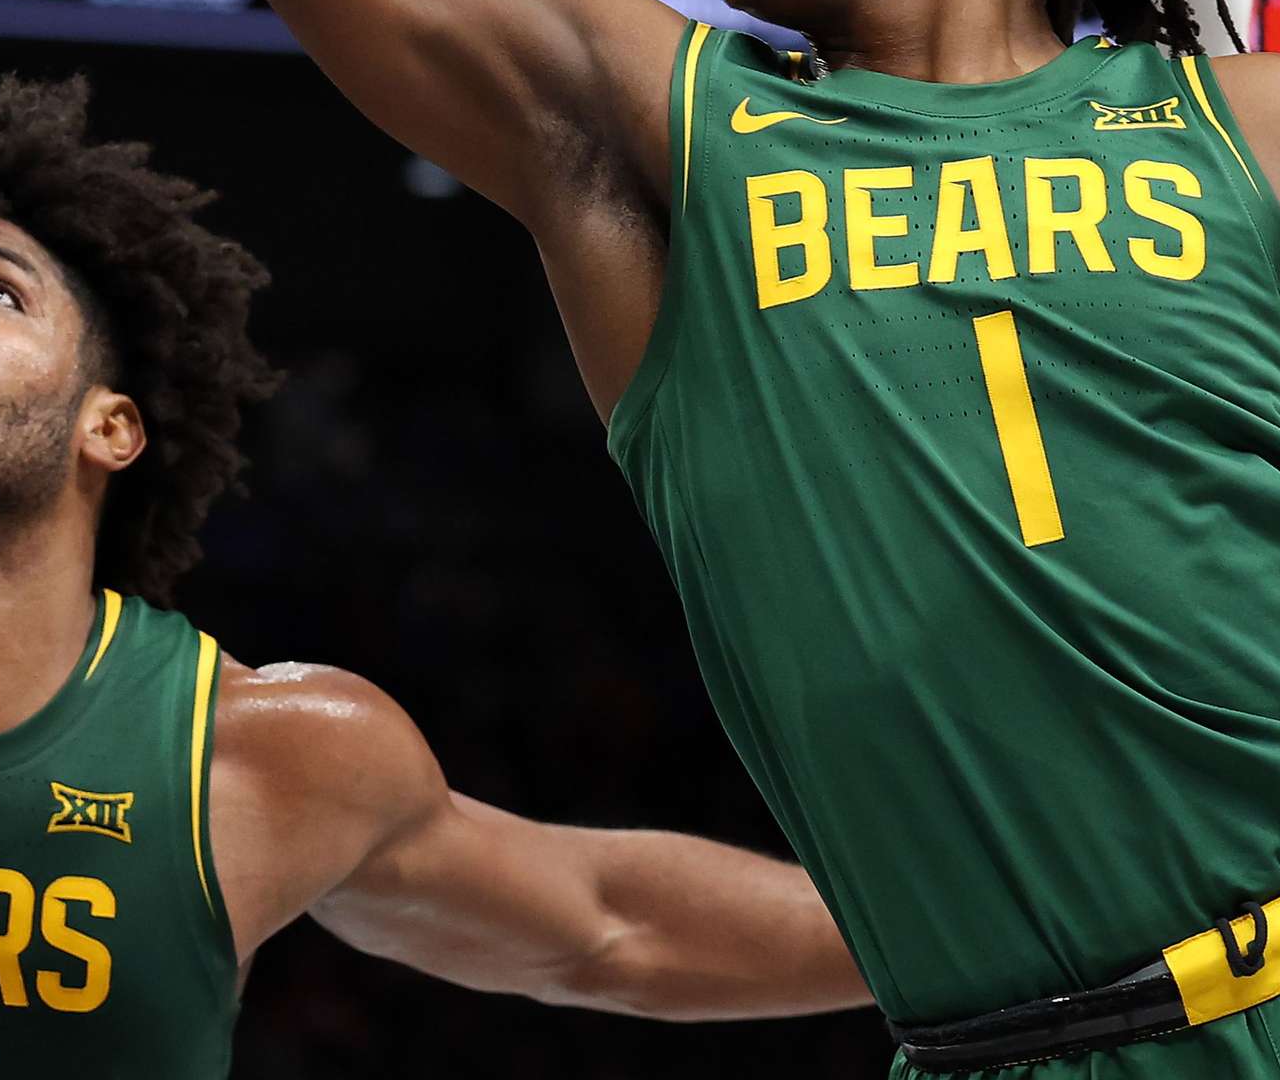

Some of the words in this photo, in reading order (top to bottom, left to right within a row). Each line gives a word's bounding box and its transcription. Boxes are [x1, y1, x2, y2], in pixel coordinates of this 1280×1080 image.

[745, 155, 1207, 311] BEARS
[972, 310, 1065, 548] 1
[49, 783, 133, 840] XII
